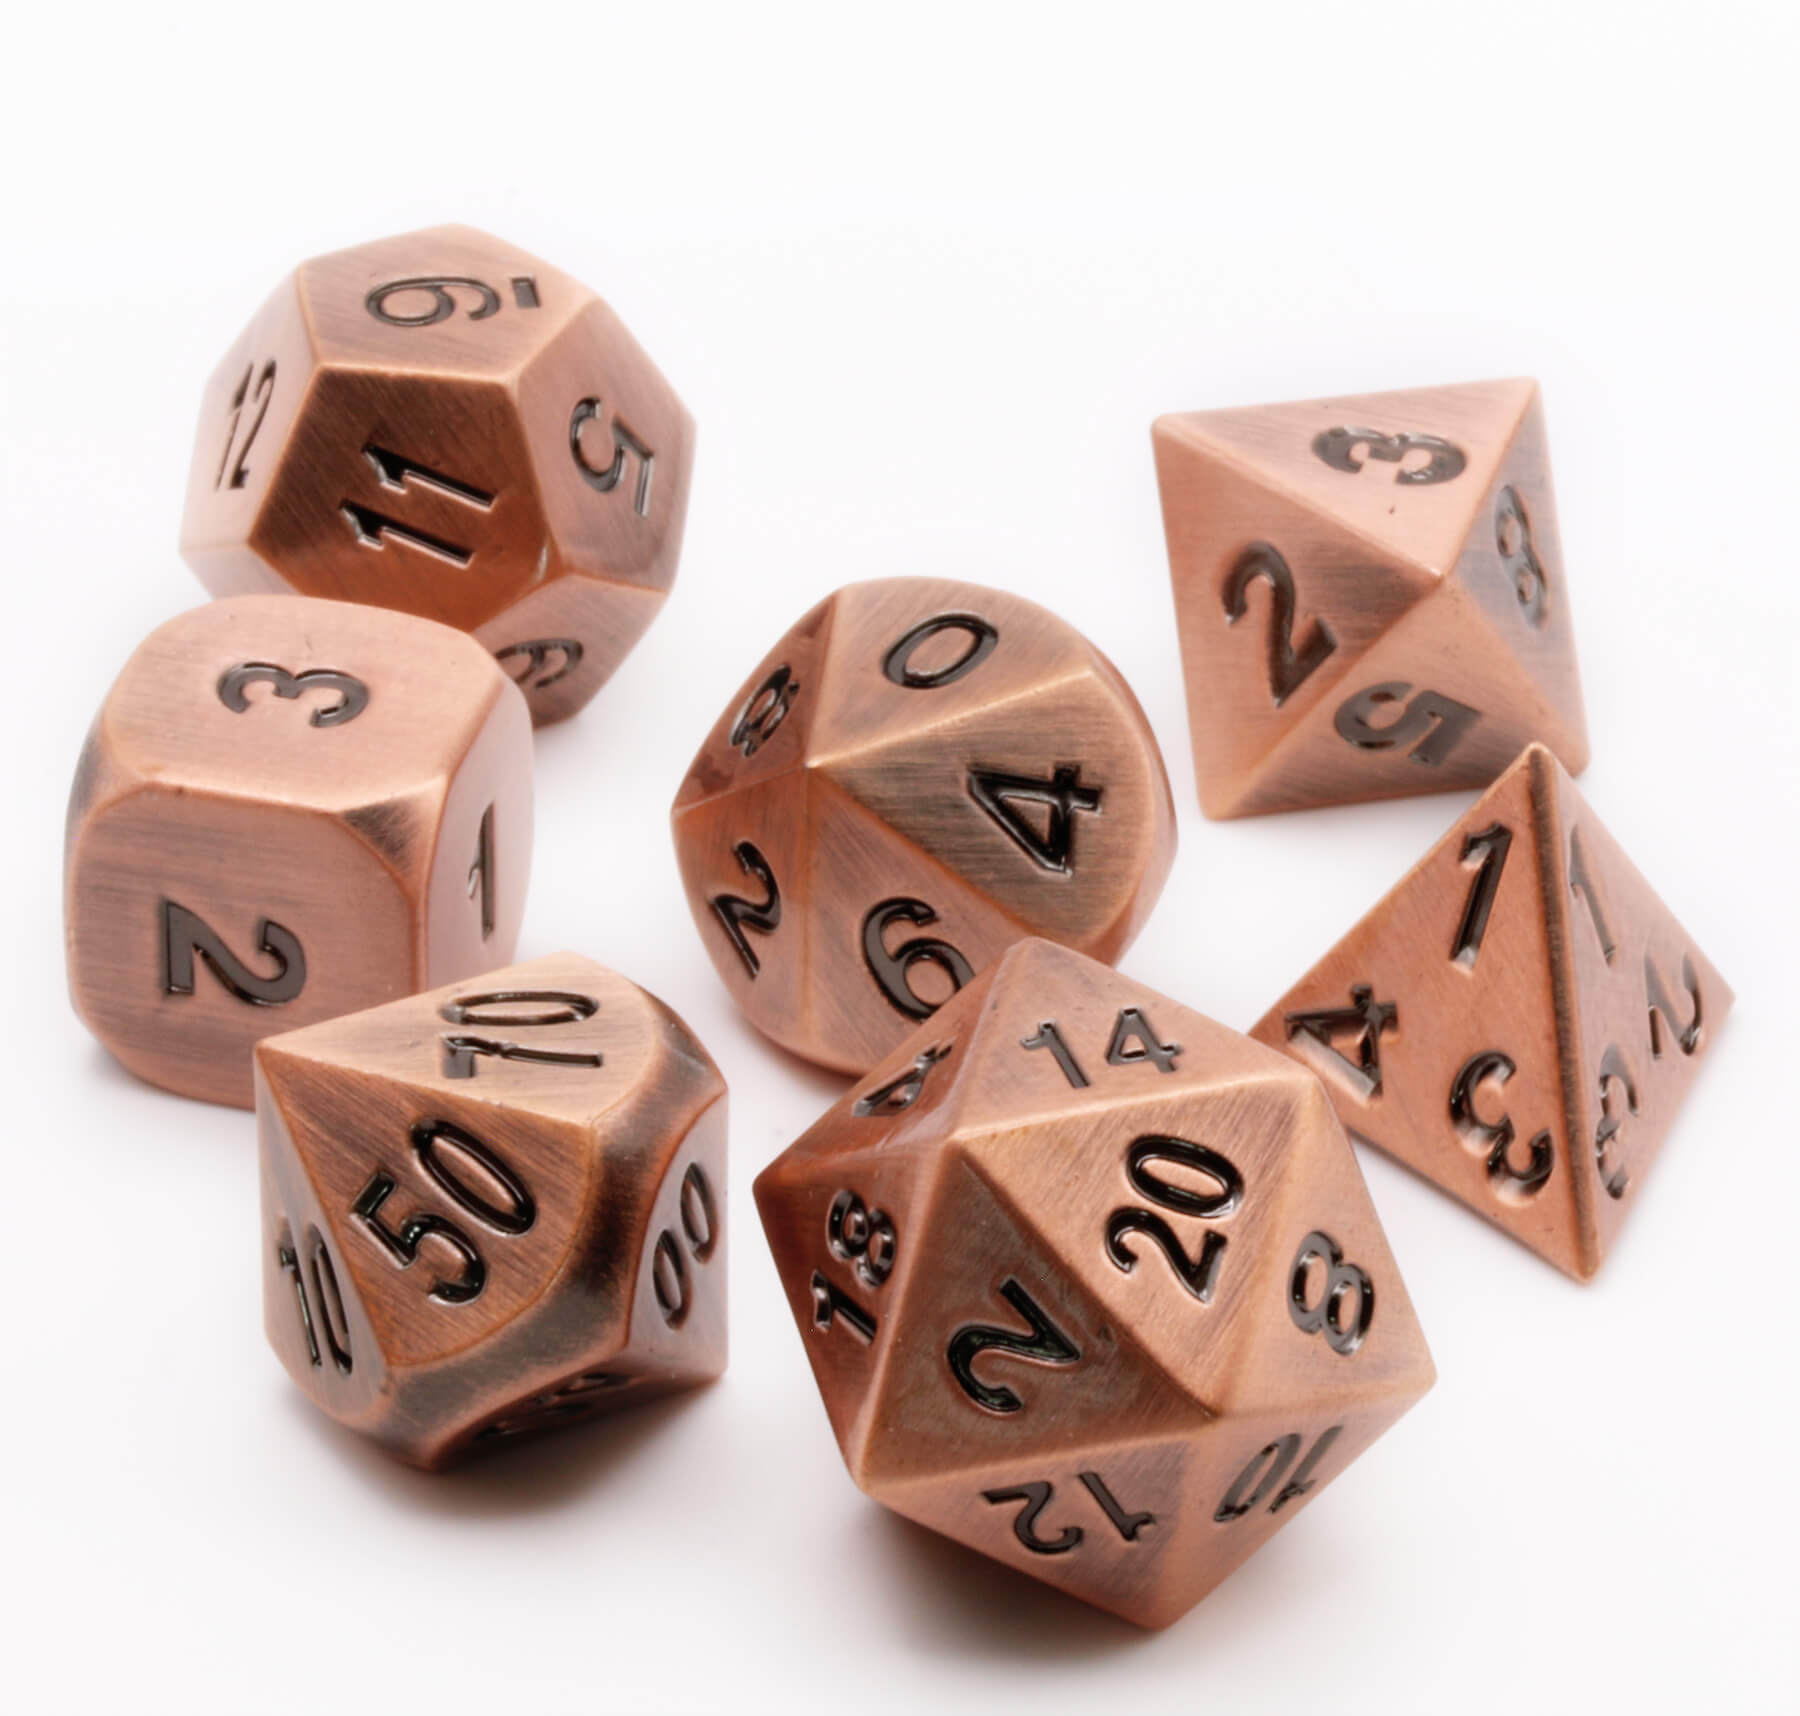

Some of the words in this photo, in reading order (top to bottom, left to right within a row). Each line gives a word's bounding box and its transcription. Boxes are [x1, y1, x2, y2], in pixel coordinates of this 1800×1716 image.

[214, 359, 277, 491] 12
[568, 396, 654, 518] 5
[1312, 426, 1467, 486] 3
[338, 443, 499, 569] 11
[1494, 484, 1548, 631] 8
[881, 611, 999, 689] 0
[1221, 540, 1337, 709] 2
[217, 661, 370, 728] 3
[1334, 681, 1484, 766] 5
[467, 801, 496, 943] 1
[966, 765, 1104, 879] 4
[160, 894, 308, 1007] 2
[709, 840, 781, 981] 2
[1449, 822, 1512, 974] 1
[1568, 822, 1615, 967] 1
[861, 896, 976, 1024] 6
[1644, 950, 1702, 1061] 2
[1021, 1007, 1182, 1089] 14
[1284, 984, 1399, 1103] 4
[1449, 1050, 1555, 1206] 3
[1596, 1043, 1638, 1200] 3
[350, 1118, 537, 1305] 50
[653, 1162, 719, 1330] 00
[810, 1189, 897, 1345] 18
[1105, 1134, 1245, 1304] 20
[278, 1218, 353, 1375] 10
[947, 1276, 1082, 1412] 2
[1289, 1230, 1375, 1356] 8
[980, 1470, 1156, 1555] 12
[1214, 1425, 1344, 1522] 10
